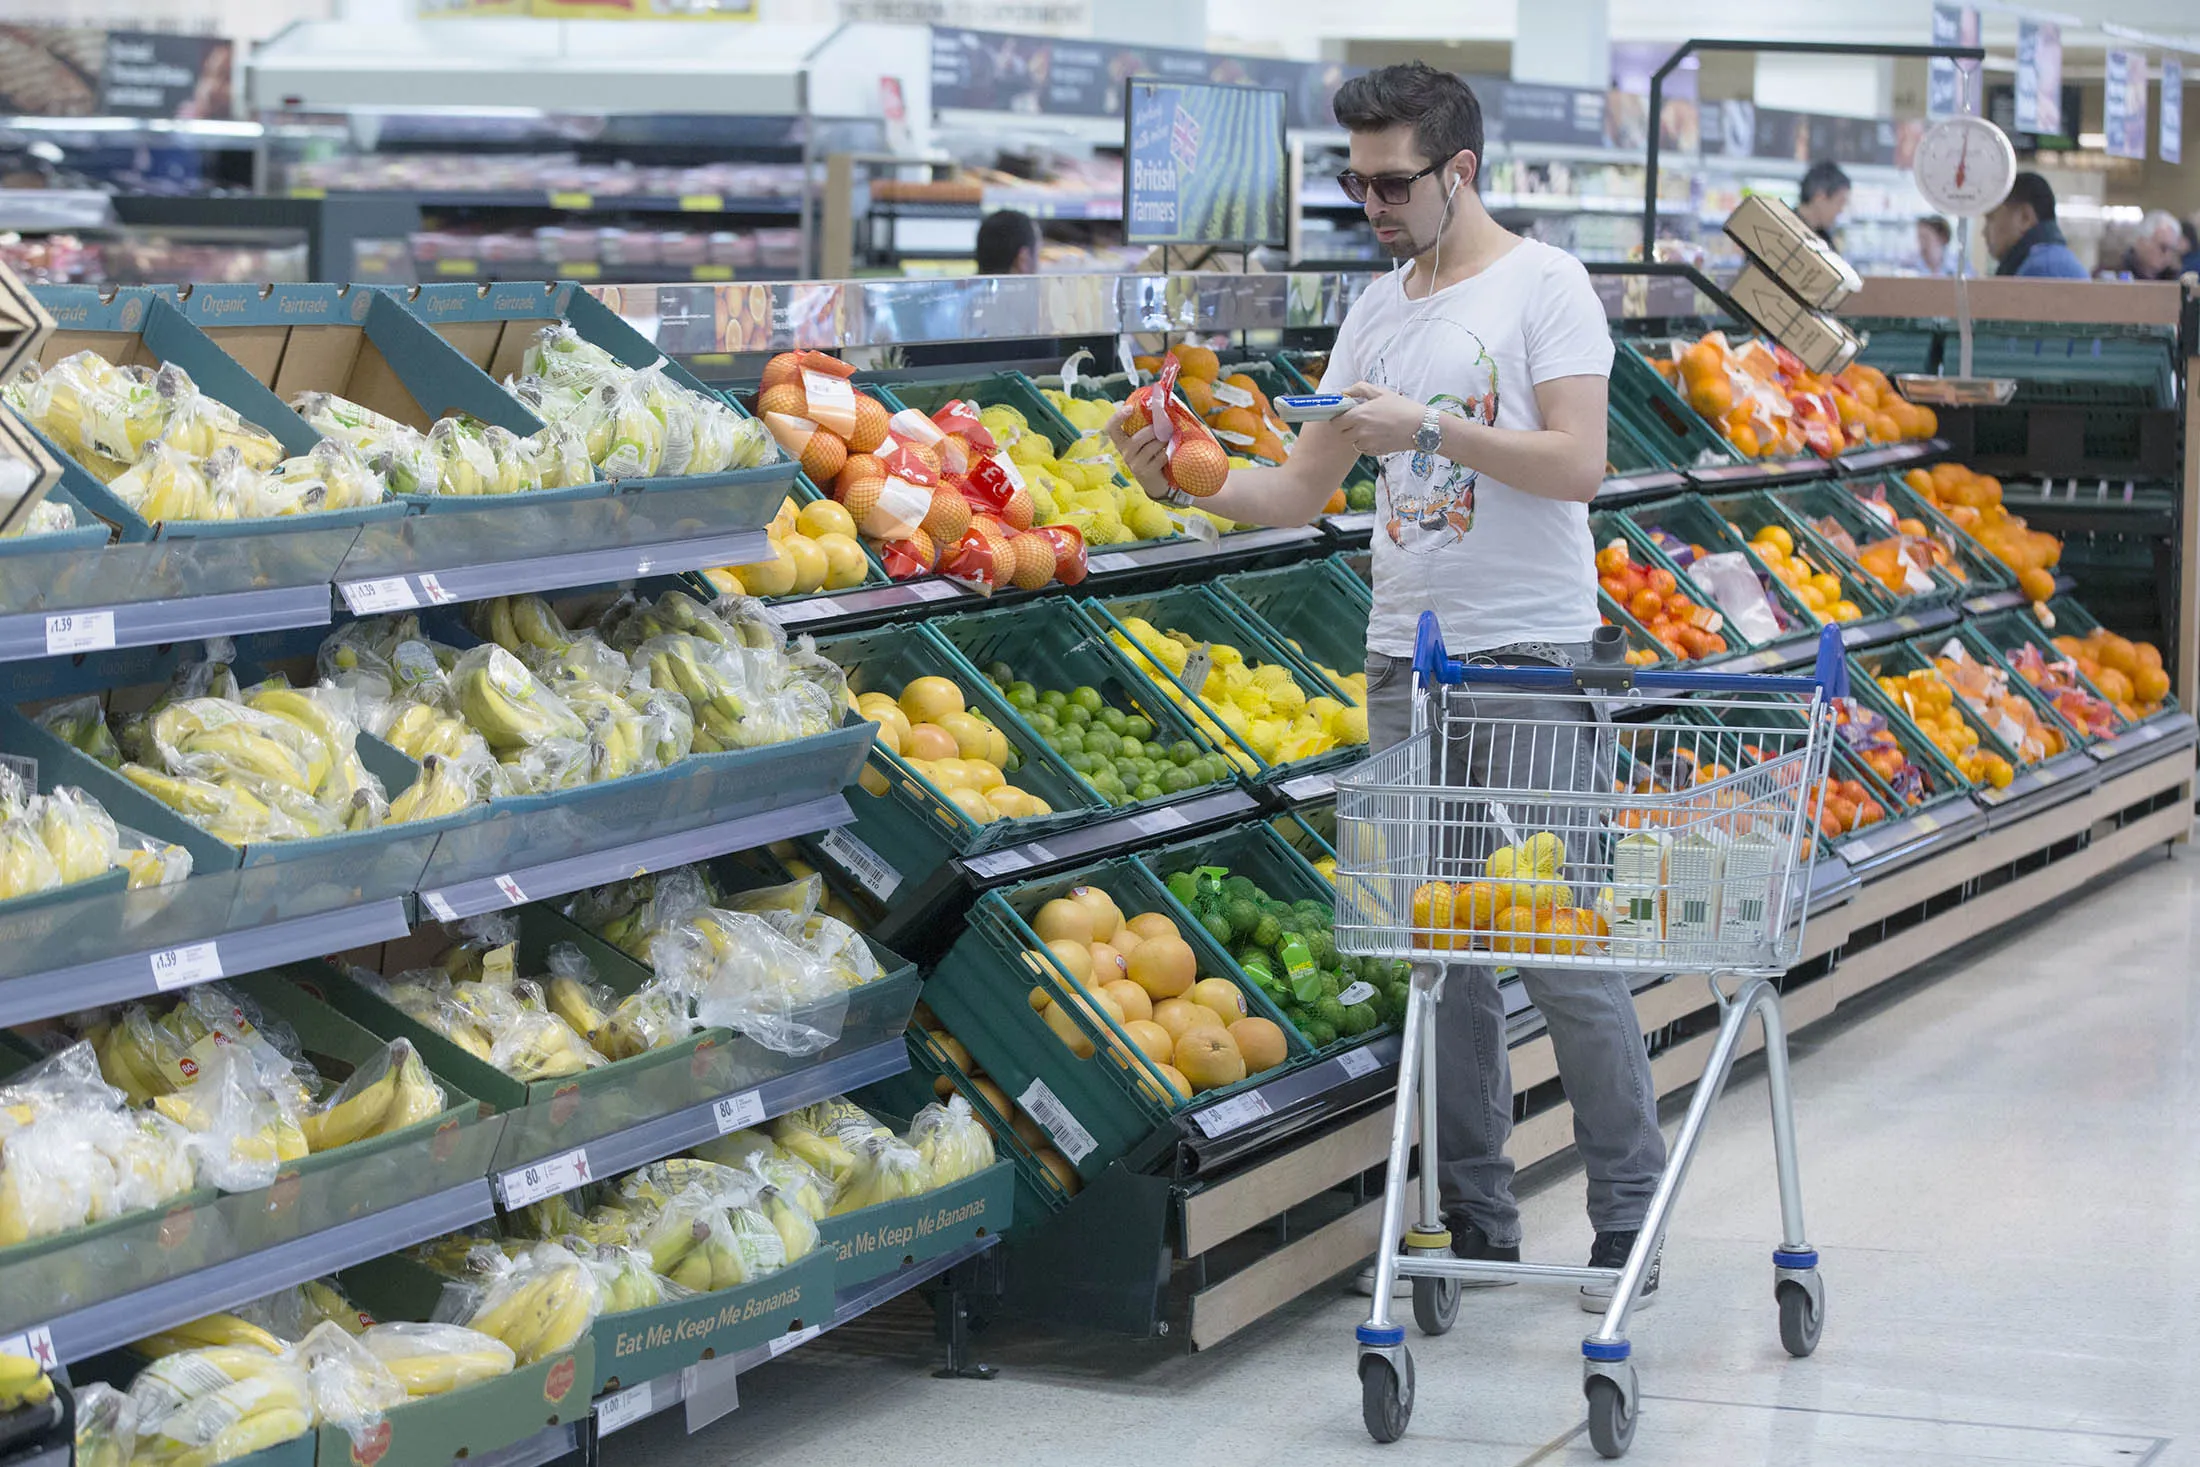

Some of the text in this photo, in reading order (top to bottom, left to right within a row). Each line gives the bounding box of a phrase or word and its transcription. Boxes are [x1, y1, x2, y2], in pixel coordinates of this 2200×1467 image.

[1134, 159, 1176, 191] British
[1133, 193, 1176, 222] farmers
[202, 294, 328, 317] Organic Fairtrade
[426, 294, 535, 316] Organic Fairtrade
[867, 879, 880, 891] 210
[856, 1231, 875, 1256] Me
[878, 1225, 913, 1249] Keep
[916, 1215, 934, 1239] Me
[936, 1198, 985, 1230] Bananas
[615, 1286, 801, 1358] Eat Me Keep Me Bananas
